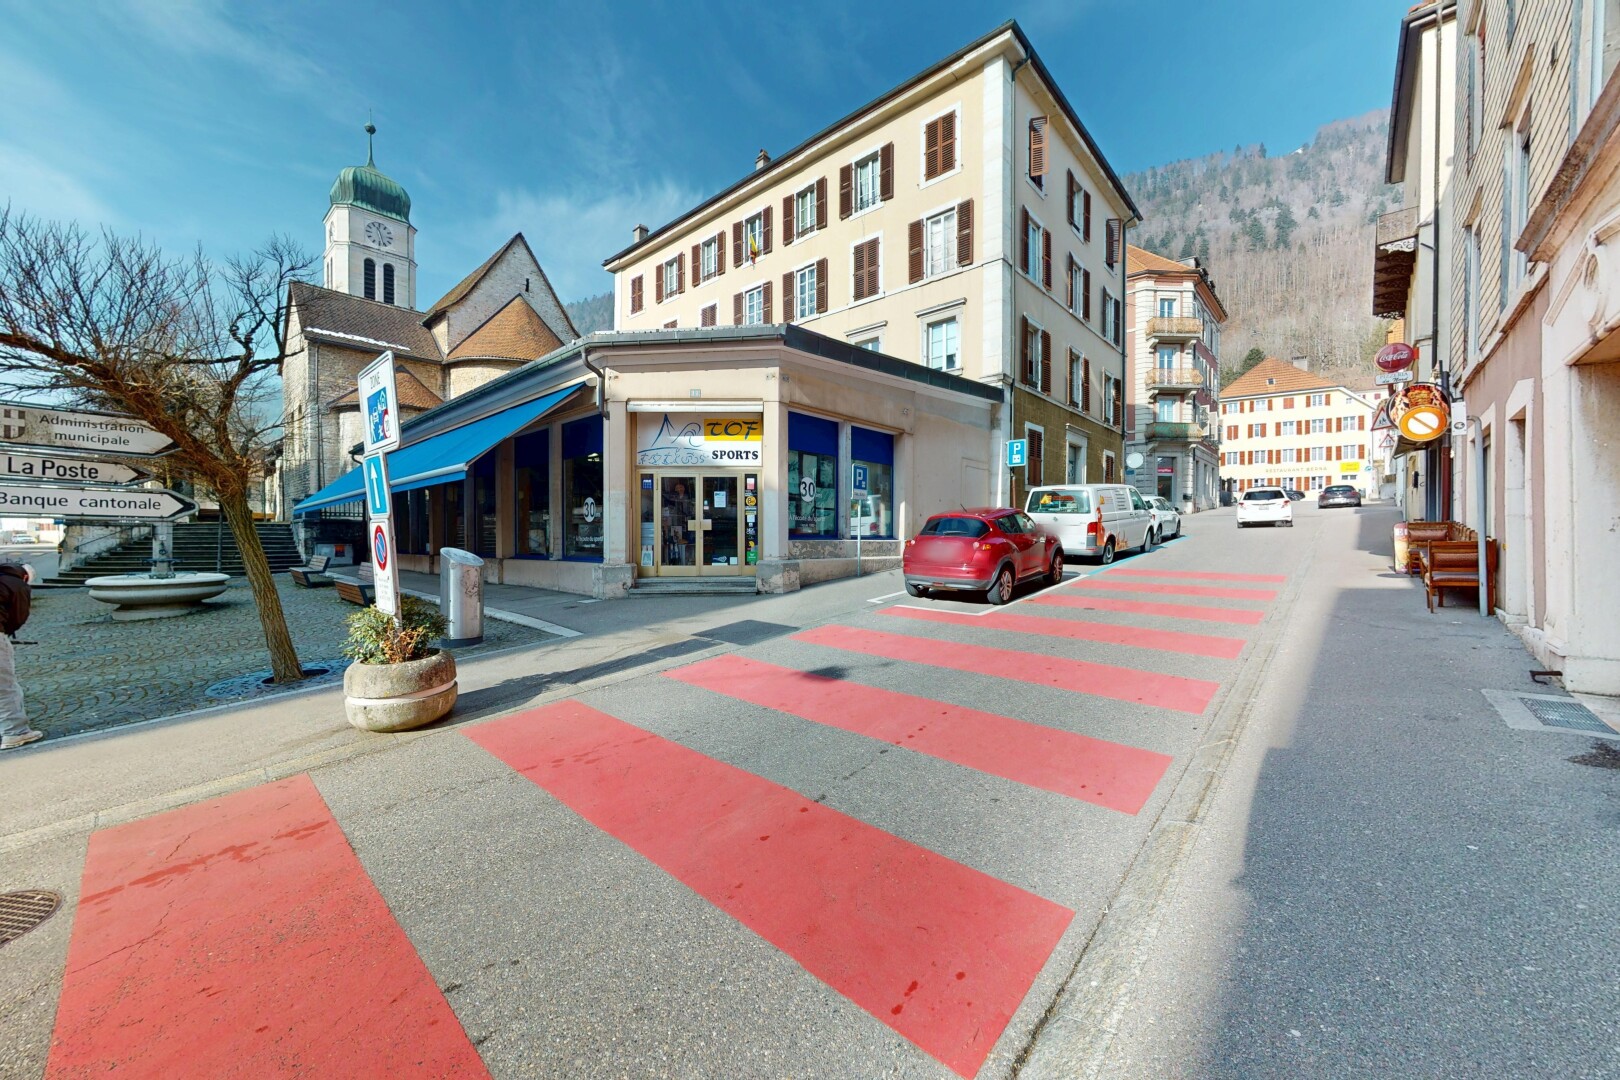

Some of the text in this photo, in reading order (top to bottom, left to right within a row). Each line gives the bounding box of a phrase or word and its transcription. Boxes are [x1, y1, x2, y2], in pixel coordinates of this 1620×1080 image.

[1379, 350, 1409, 363] Coca-Cola
[370, 371, 380, 389] ZONE
[40, 415, 144, 434] Administration
[54, 431, 130, 446] municipale
[712, 450, 759, 460] SPORTS
[1013, 442, 1021, 455] P
[7, 456, 99, 480] La Poste
[856, 468, 864, 486] P
[801, 481, 815, 498] 30
[0, 491, 162, 510] Banque cantonale
[584, 501, 595, 518] 30
